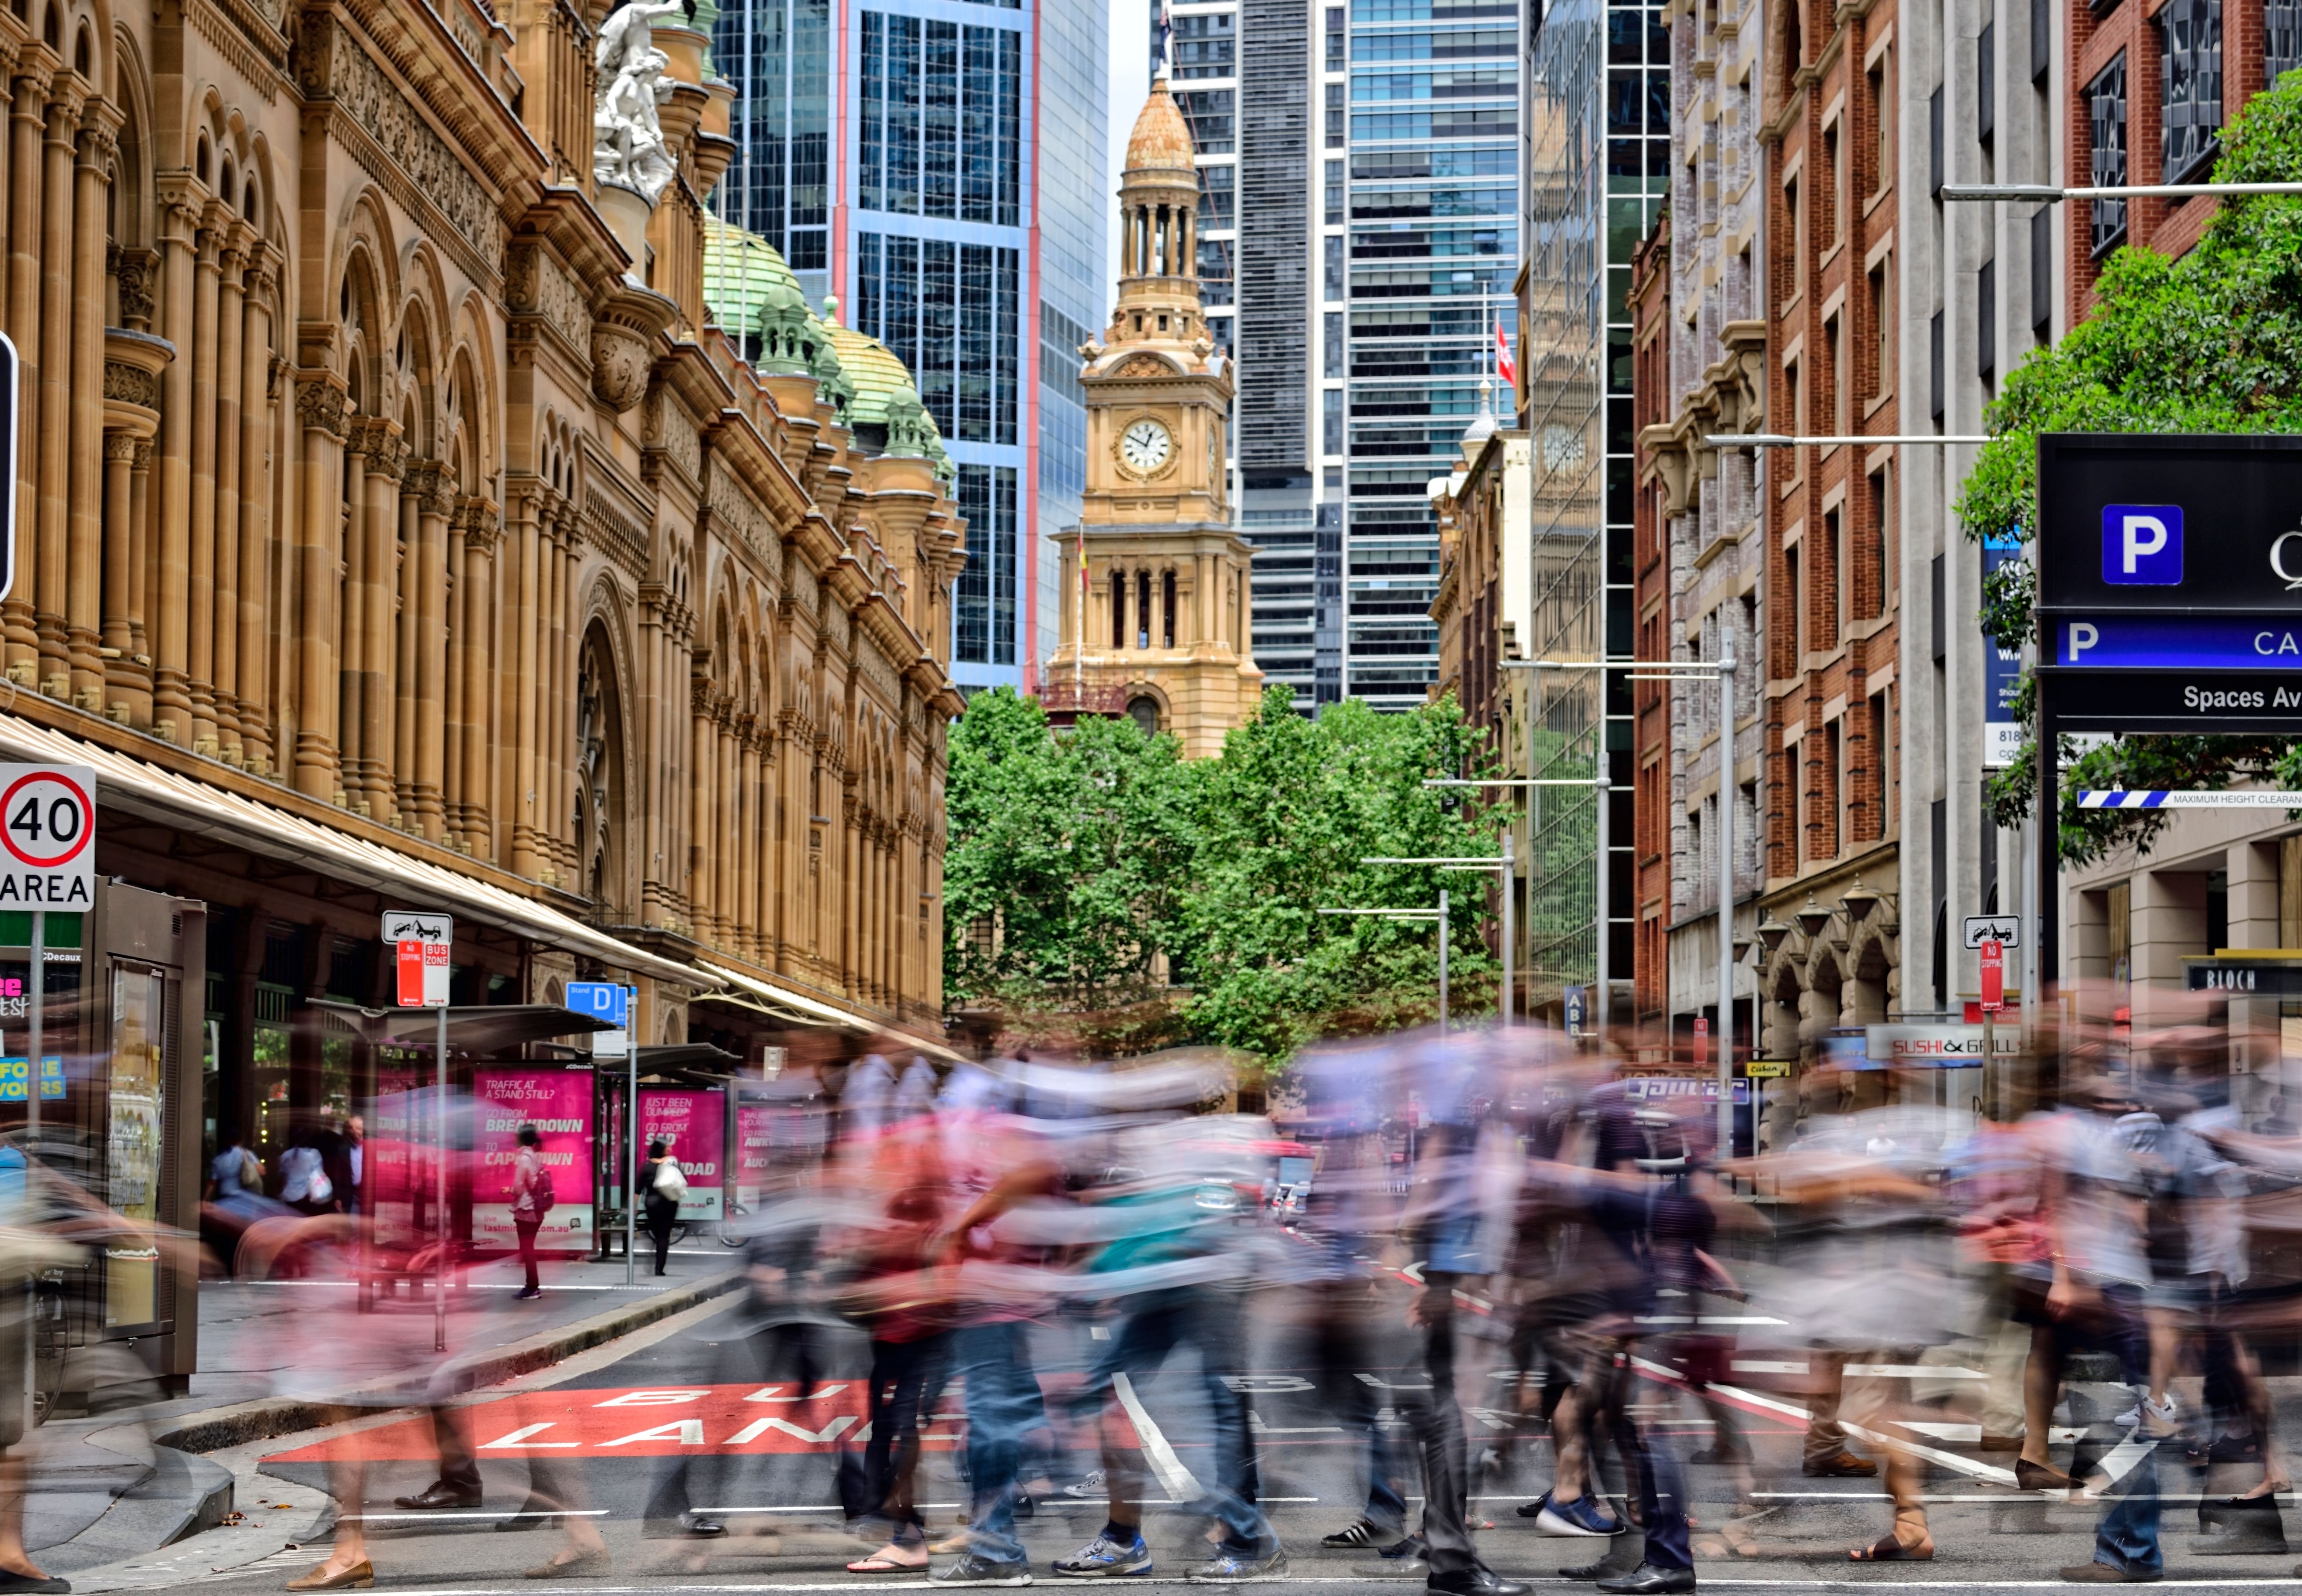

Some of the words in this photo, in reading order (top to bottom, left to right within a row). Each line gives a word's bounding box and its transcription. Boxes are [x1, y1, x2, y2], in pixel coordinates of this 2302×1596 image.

[2123, 516, 2168, 573] P
[2069, 623, 2099, 661] P
[2184, 686, 2265, 712] Spaces
[2272, 686, 2302, 707] Av
[2174, 795, 2218, 803] MAXIMUM
[2221, 795, 2255, 803] HEIGHT
[2258, 795, 2302, 804] CLEARAN
[10, 798, 79, 842] 40
[0, 874, 88, 903] AREA
[427, 945, 447, 955] BUS
[1988, 945, 1996, 956] NO
[43, 952, 81, 961] CDecaux
[426, 956, 447, 965] ZONE
[1982, 959, 2002, 968] STOPPING
[2207, 970, 2255, 990] BLOCH
[0, 978, 21, 996] e
[594, 987, 611, 1010] D
[1893, 1040, 1943, 1053] SUSHI
[486, 1080, 522, 1089] TRAFFIC
[524, 1080, 536, 1089] AT
[485, 1090, 492, 1099] A
[494, 1090, 524, 1099] STAND
[525, 1089, 555, 1099] STILL?
[645, 1098, 667, 1108] JUST
[668, 1098, 692, 1107] BEEN
[485, 1109, 498, 1118] GO
[500, 1109, 528, 1118] FROM
[646, 1122, 658, 1132] GO
[660, 1123, 687, 1132] FROM
[486, 1142, 497, 1151] TO
[485, 1152, 518, 1165] CAP
[535, 1152, 573, 1165] OWN
